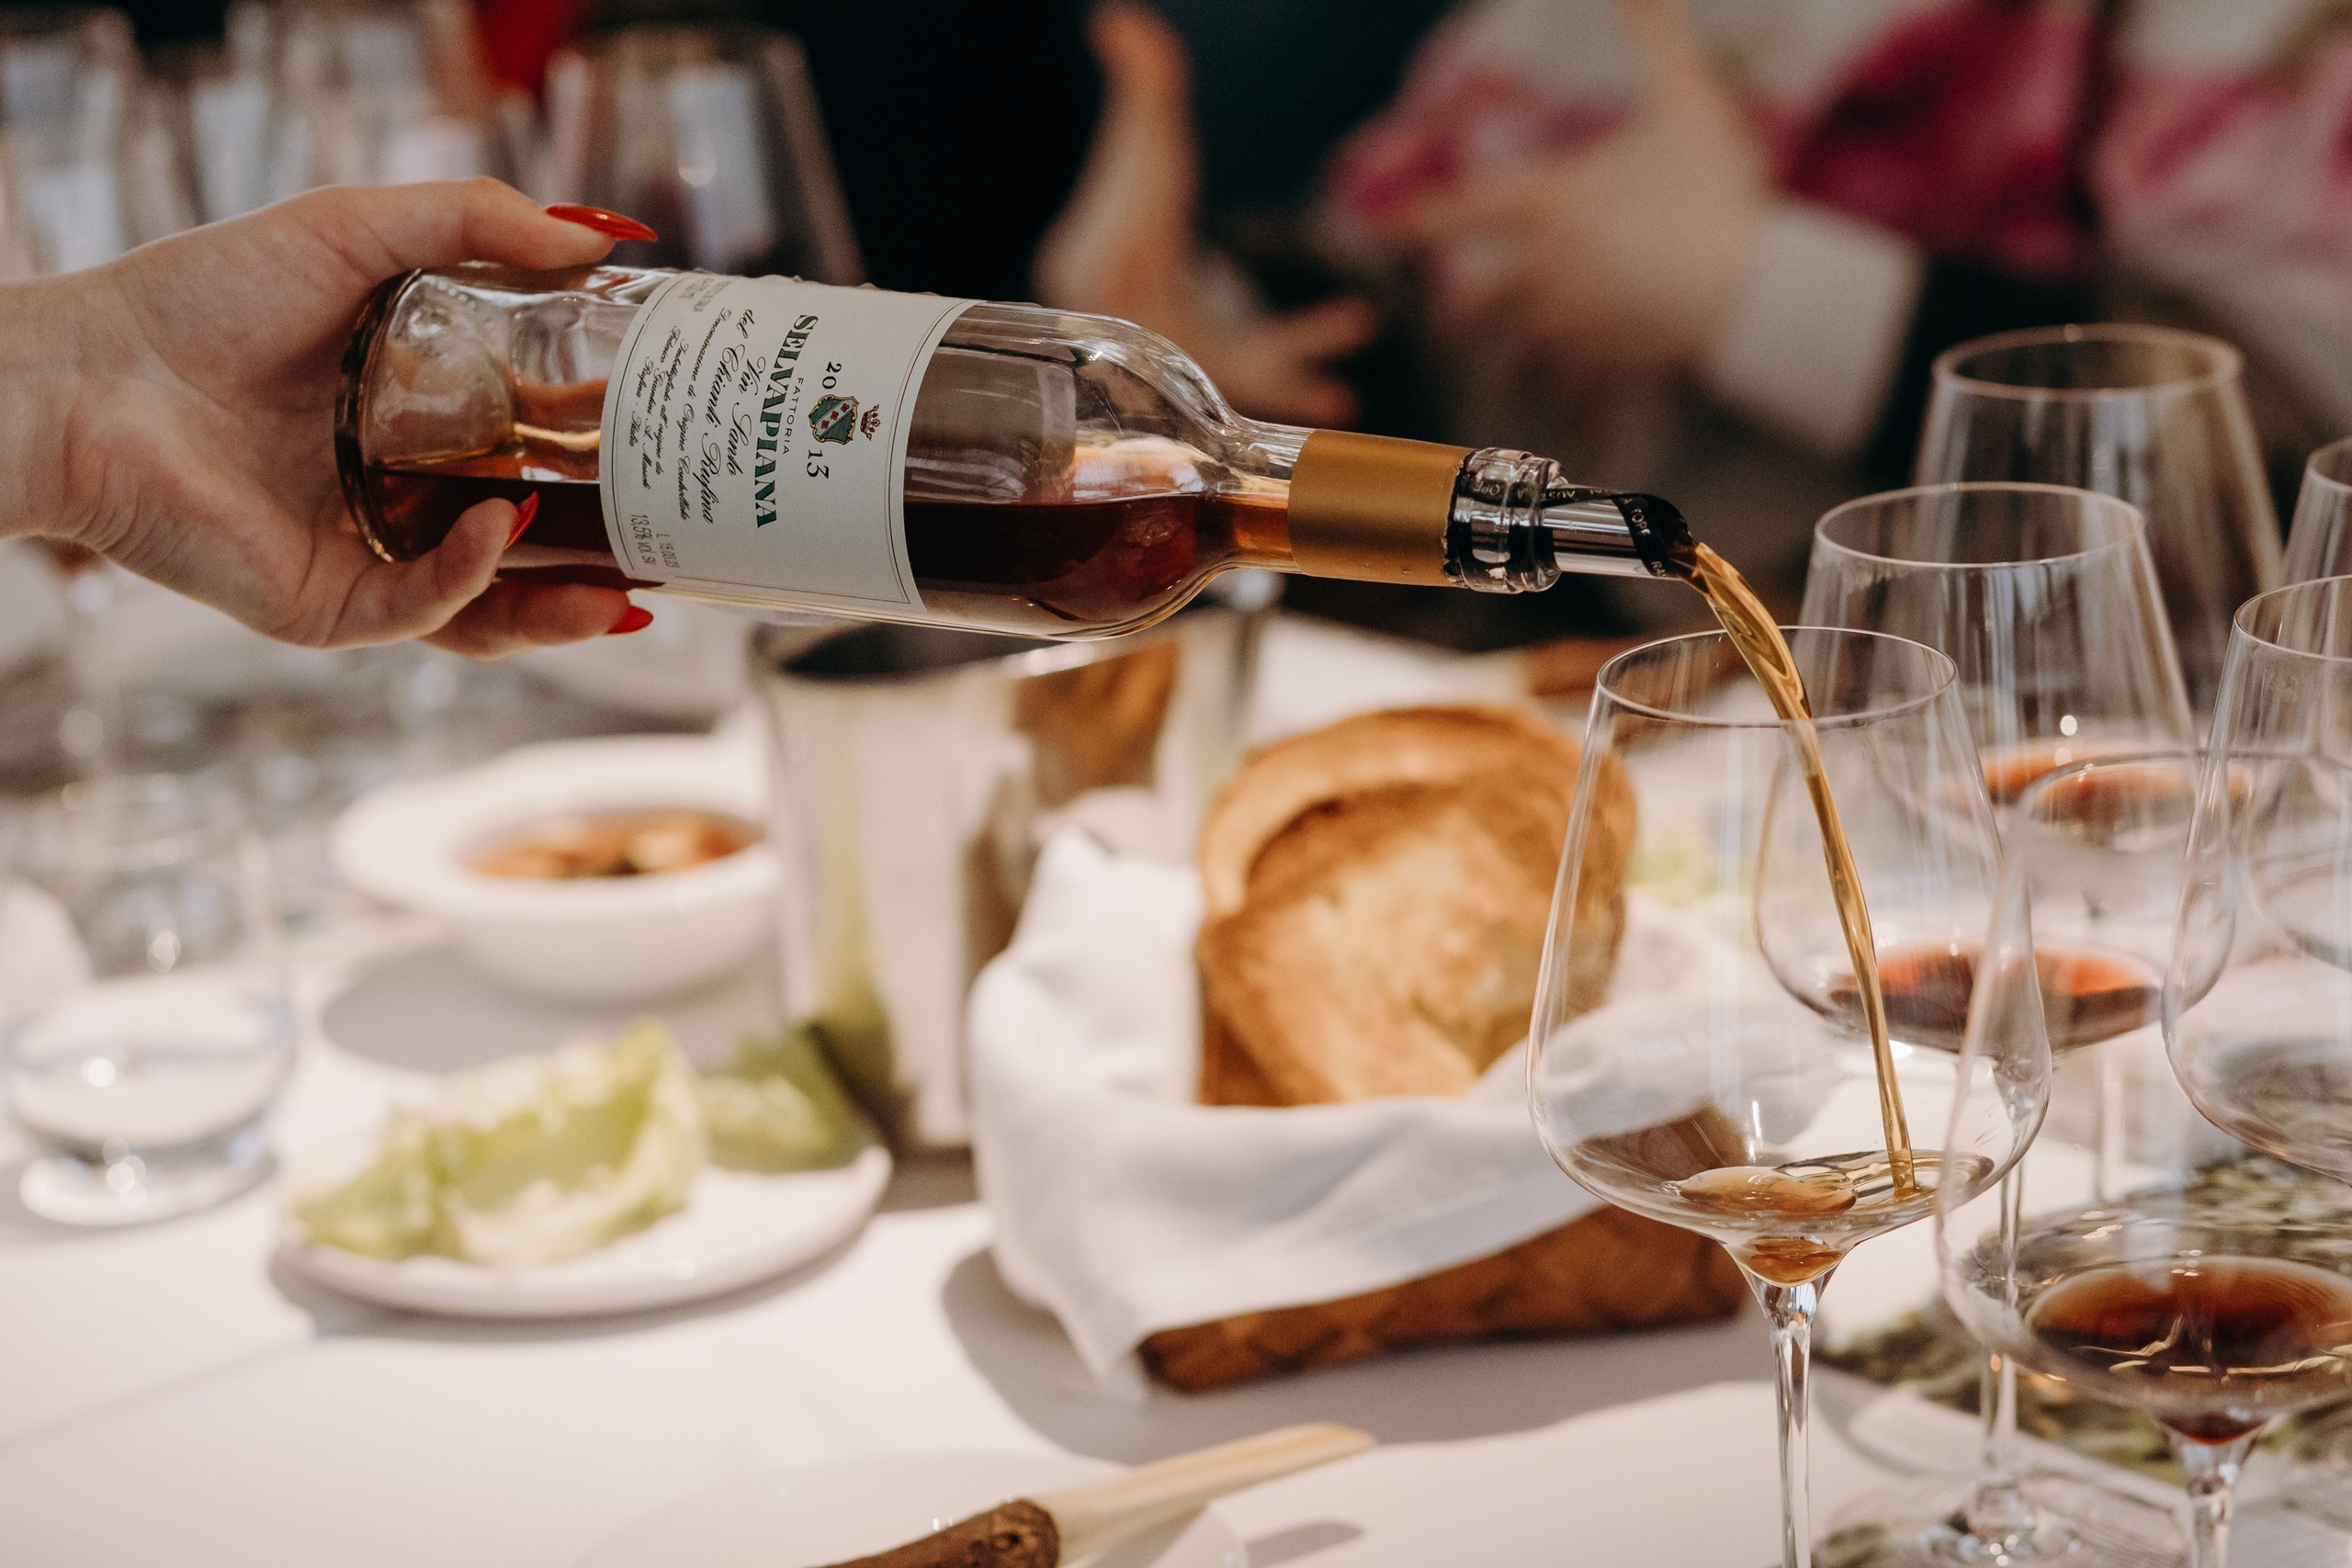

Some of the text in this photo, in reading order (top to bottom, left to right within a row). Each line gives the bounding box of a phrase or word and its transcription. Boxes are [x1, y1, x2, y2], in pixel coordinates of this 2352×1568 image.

[660, 325, 682, 363] Federico
[690, 307, 732, 382] Denominazione
[737, 309, 755, 339] del
[636, 355, 655, 398] Rufina
[686, 384, 696, 400] di
[705, 344, 746, 428] Chianti
[676, 403, 695, 452] Origine
[726, 355, 766, 477] Vin Santo
[754, 314, 819, 529] SELVAPIANA
[782, 377, 804, 455] FATTORIA
[806, 361, 842, 479] 20 13
[655, 461, 664, 475] da
[677, 456, 691, 521] Controllata
[692, 433, 722, 525] Rufina
